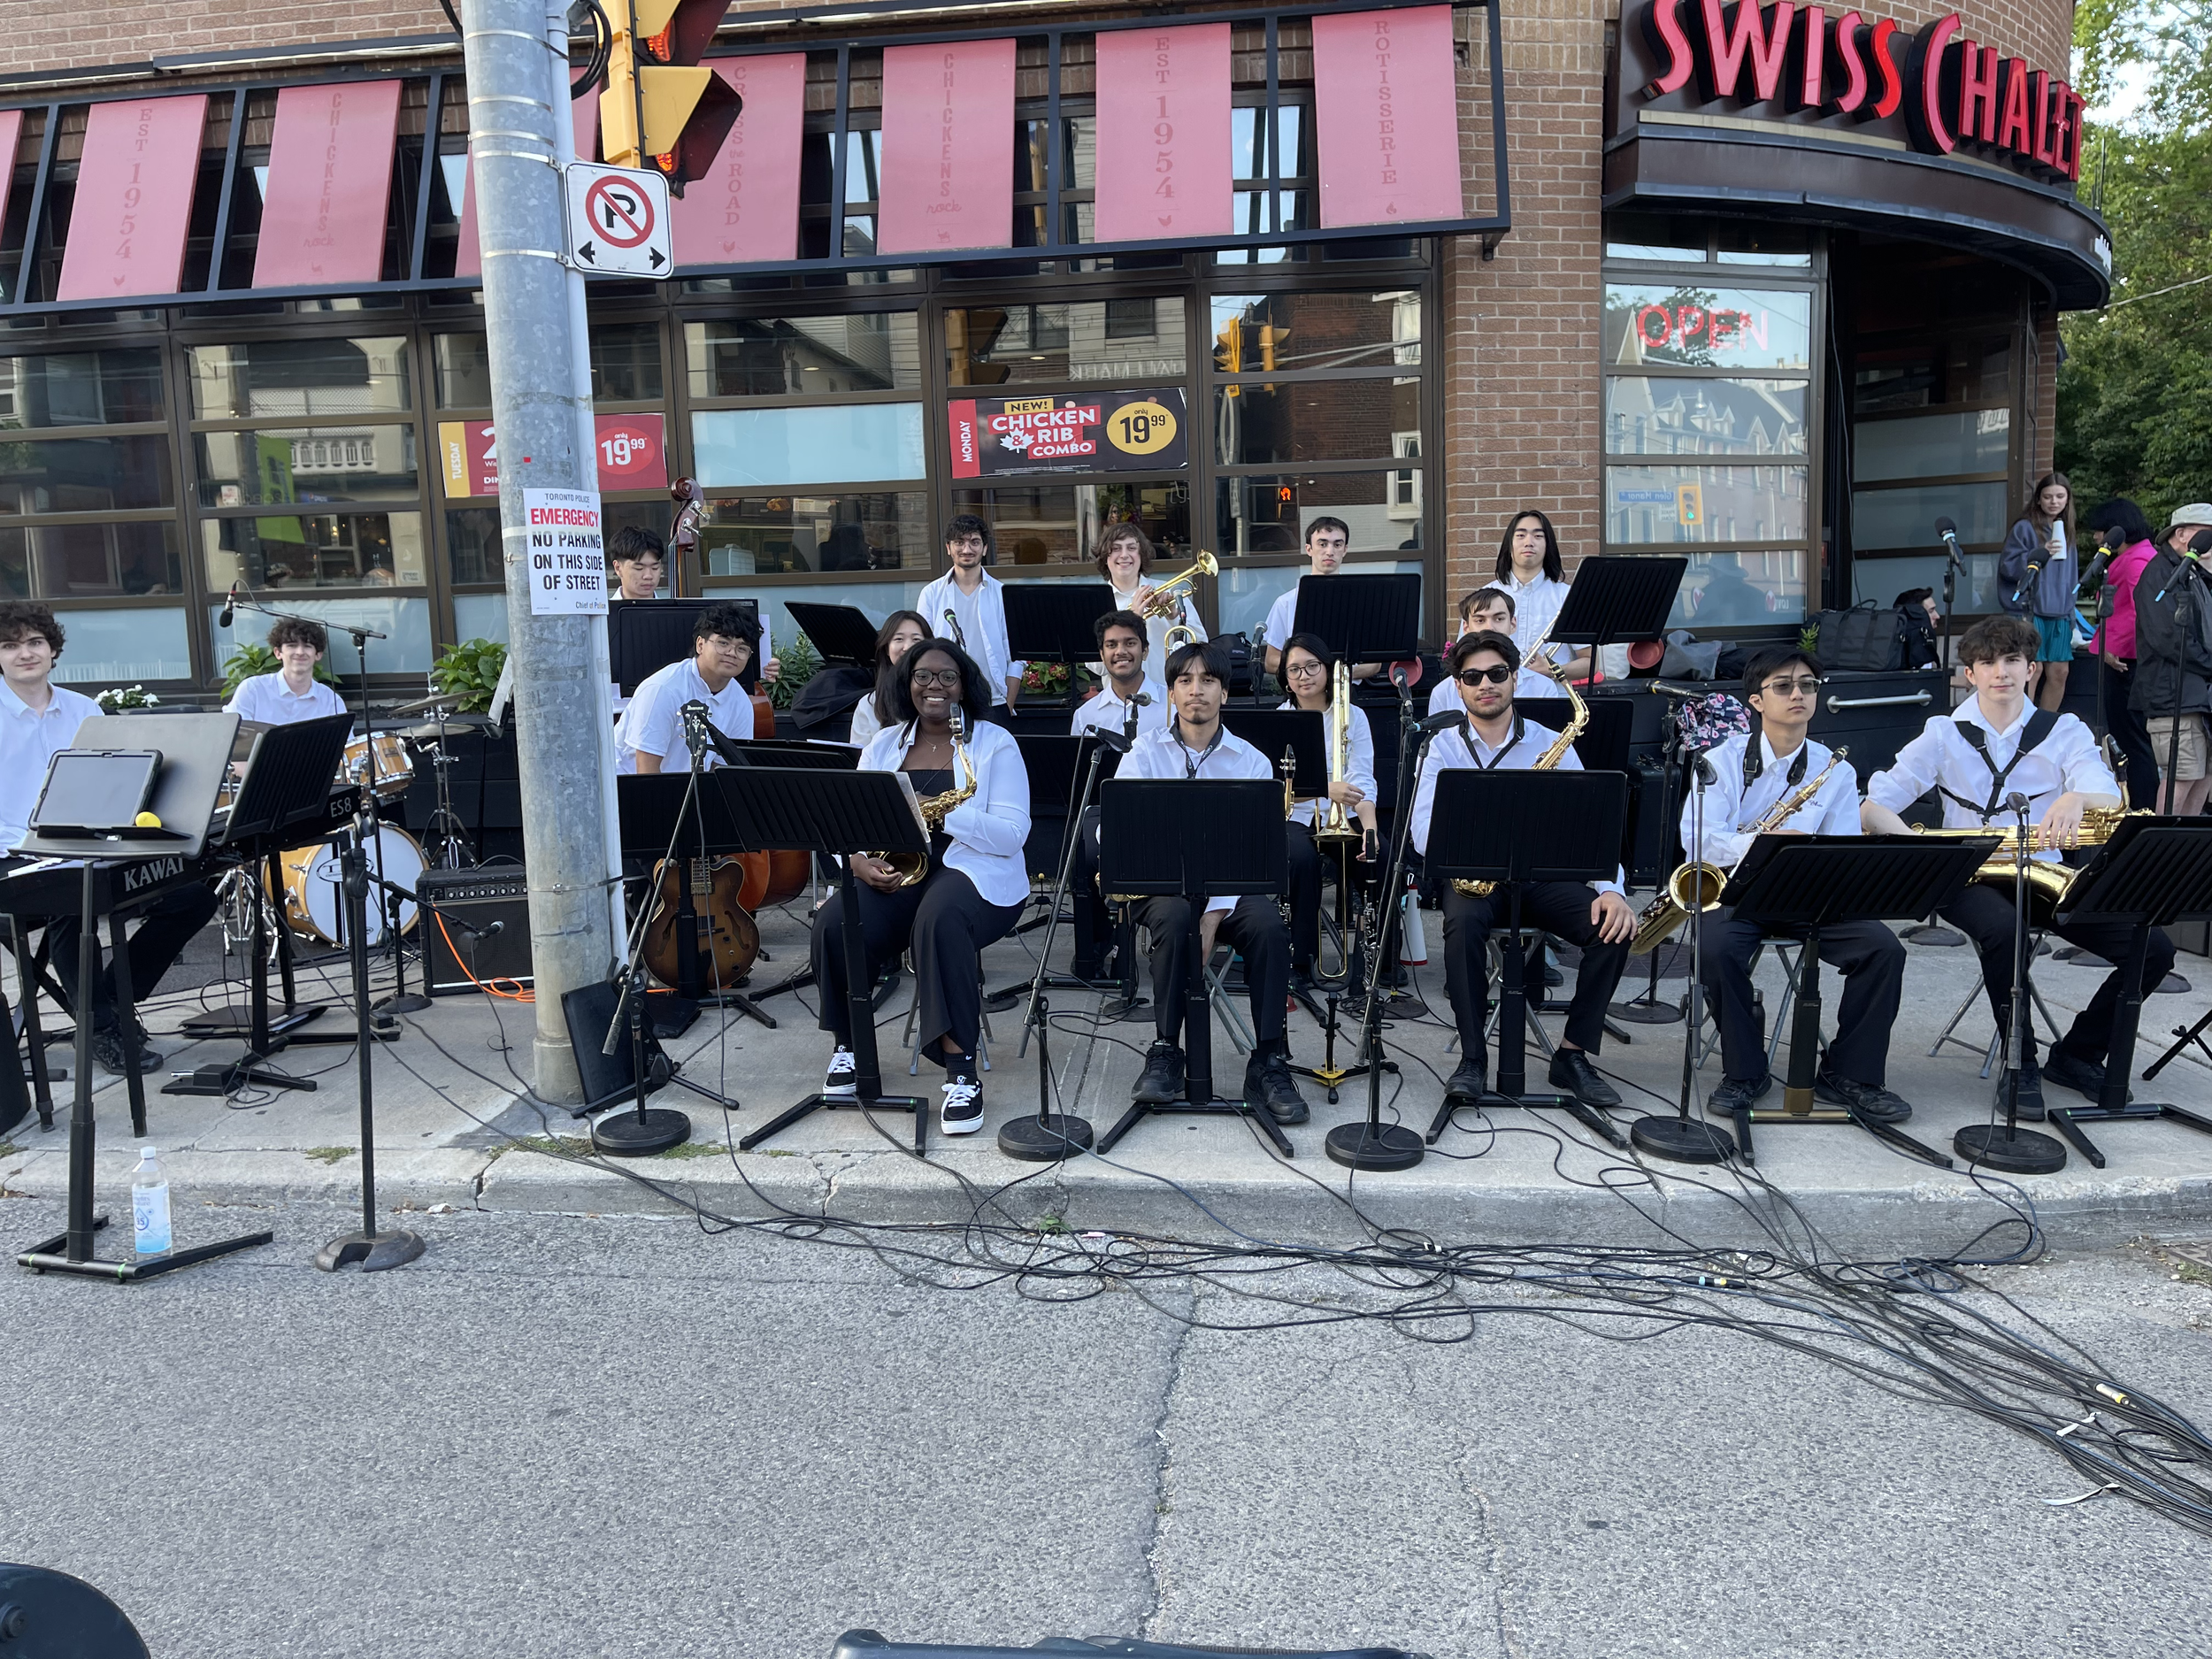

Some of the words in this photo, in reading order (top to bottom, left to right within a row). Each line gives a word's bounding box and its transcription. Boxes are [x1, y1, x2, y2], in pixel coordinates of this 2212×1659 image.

[1155, 37, 1170, 83] EST
[733, 66, 747, 144] CRSS
[1374, 20, 1397, 184] ROTISSERIE
[1651, 0, 1903, 119] SWISS
[1921, 12, 2087, 182] CHALET
[135, 108, 152, 151] EST
[940, 53, 954, 196] CHICKENS
[319, 92, 342, 232] CHICKENS
[1154, 96, 1175, 198] 1954
[115, 162, 141, 259] 1954
[725, 163, 742, 226] ROAD
[926, 199, 962, 213] rock
[1637, 304, 1768, 350] OPEN
[992, 409, 1094, 431] CHICKEN
[1010, 401, 1048, 412] NEW!
[959, 420, 973, 463] MONDAY
[1011, 434, 1025, 447] &
[1037, 427, 1074, 443] RIB
[1032, 442, 1093, 457] COMBO
[449, 442, 462, 480] TUESDAY
[545, 493, 574, 502] TORONTO
[575, 495, 590, 503] POLICE
[530, 508, 599, 527] EMERGENCY
[532, 531, 553, 547] NO
[558, 531, 601, 549] PARKING
[534, 554, 552, 569] ON
[557, 554, 582, 569] THIS
[586, 555, 603, 571] SIDE
[542, 574, 561, 590] OF
[565, 575, 601, 590] STREET
[330, 797, 352, 818] ES8
[123, 857, 185, 892] KAWAI
